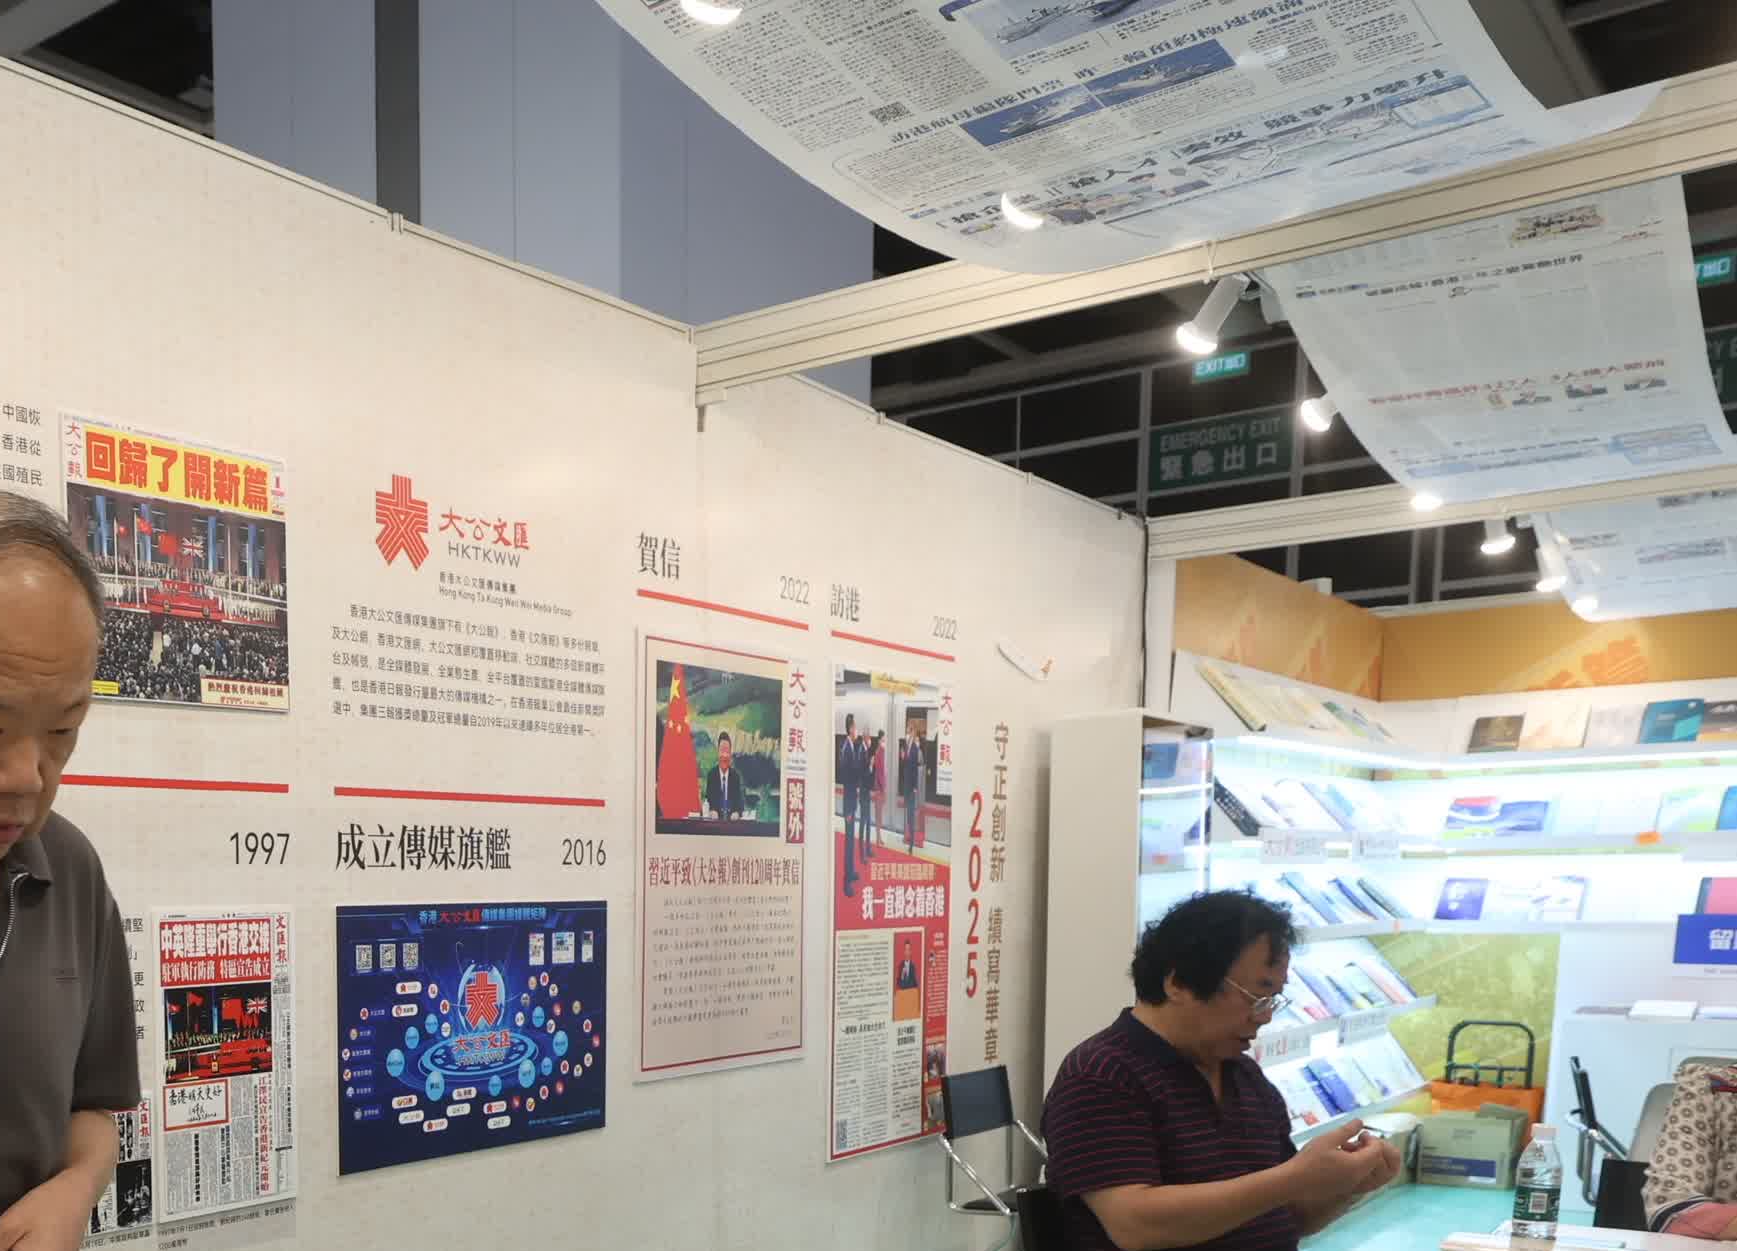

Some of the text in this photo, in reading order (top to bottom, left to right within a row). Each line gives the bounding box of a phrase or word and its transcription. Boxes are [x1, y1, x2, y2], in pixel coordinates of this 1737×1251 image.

[1160, 416, 1282, 454] EMERGENCY EXIT
[1160, 444, 1278, 482] 緊急出口
[447, 541, 522, 568] HKTKWW
[637, 532, 681, 580] 賀信
[779, 575, 810, 605] 2022
[830, 583, 861, 623] 訪港
[932, 615, 957, 641] 2022
[230, 831, 291, 867] 1997
[335, 822, 513, 873] 成立傳媒旗艦
[562, 837, 607, 868] 2016
[966, 790, 983, 999] 2025
